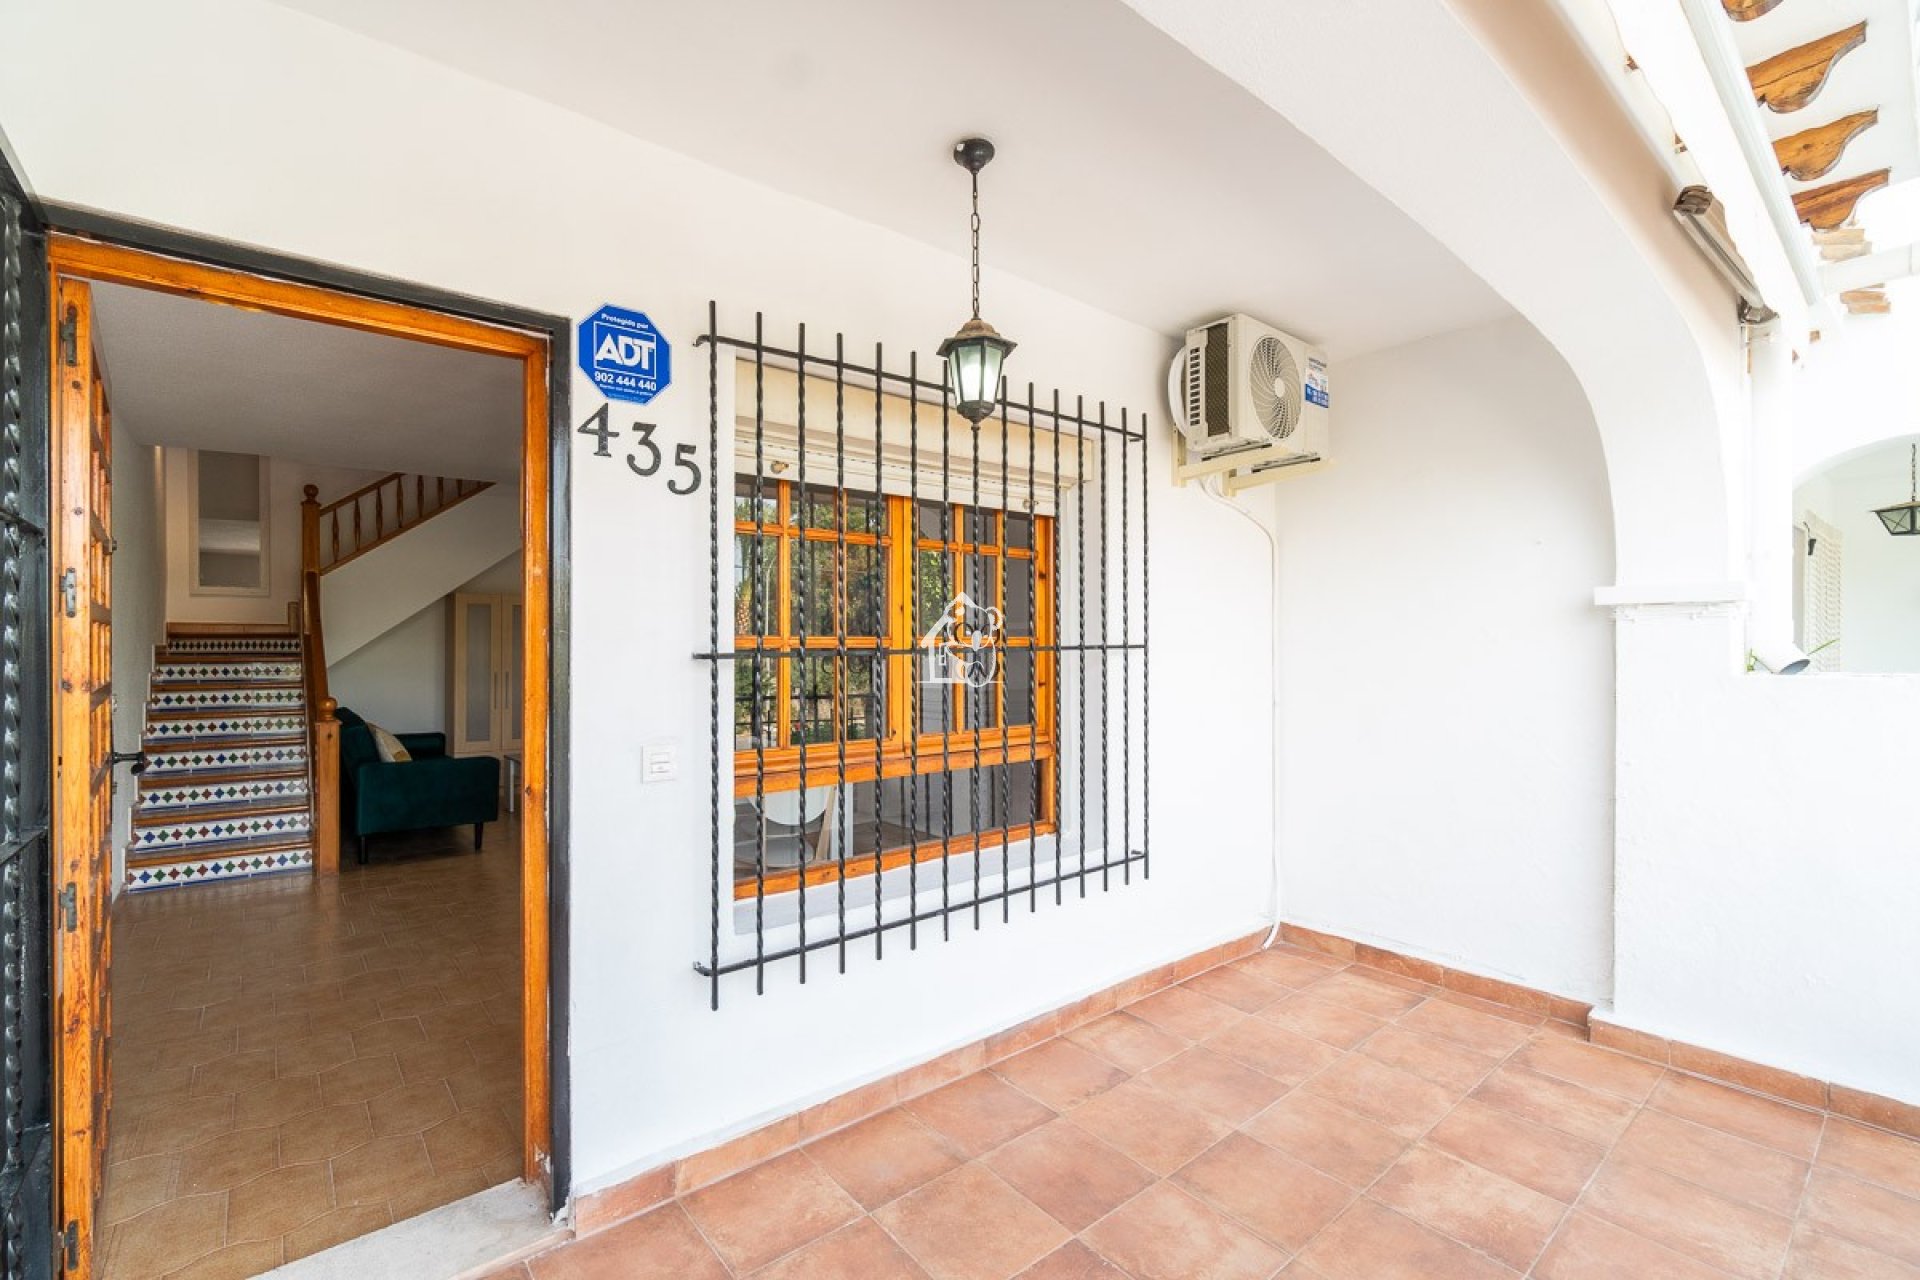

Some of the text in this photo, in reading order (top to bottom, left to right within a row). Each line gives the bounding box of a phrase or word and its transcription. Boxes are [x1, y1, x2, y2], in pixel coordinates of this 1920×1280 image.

[601, 313, 636, 327] Protegido
[595, 332, 656, 370] ADT
[594, 371, 614, 384] 902
[615, 375, 636, 388] 444
[637, 379, 657, 391] 440
[577, 402, 702, 496] 435
